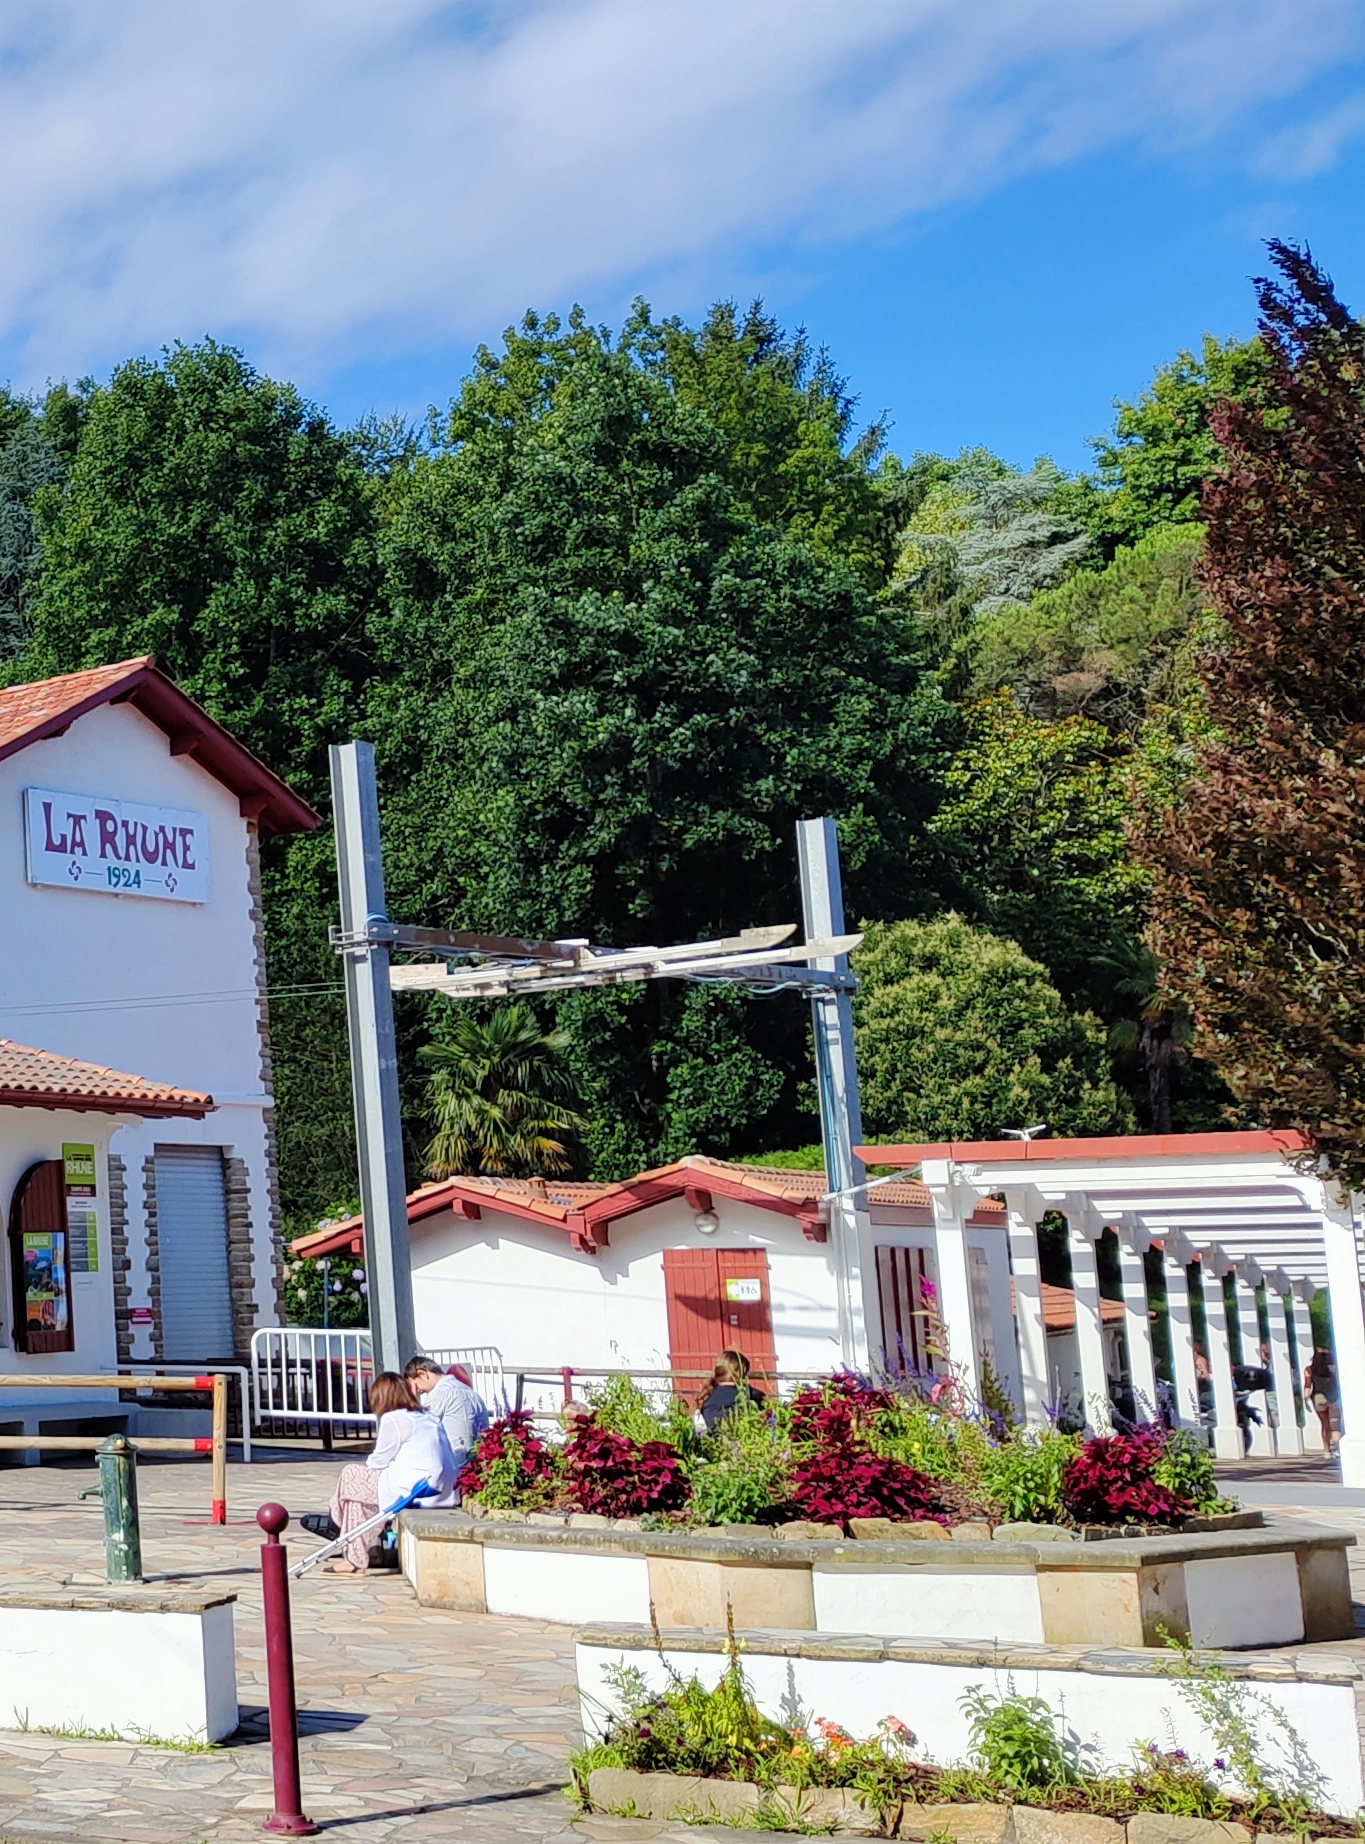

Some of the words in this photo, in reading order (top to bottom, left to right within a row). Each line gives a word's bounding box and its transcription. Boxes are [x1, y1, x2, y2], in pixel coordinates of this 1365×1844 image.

[41, 801, 89, 857] LA
[94, 808, 196, 871] RHUNE
[105, 865, 142, 889] 1924
[65, 1161, 93, 1175] RHUNE
